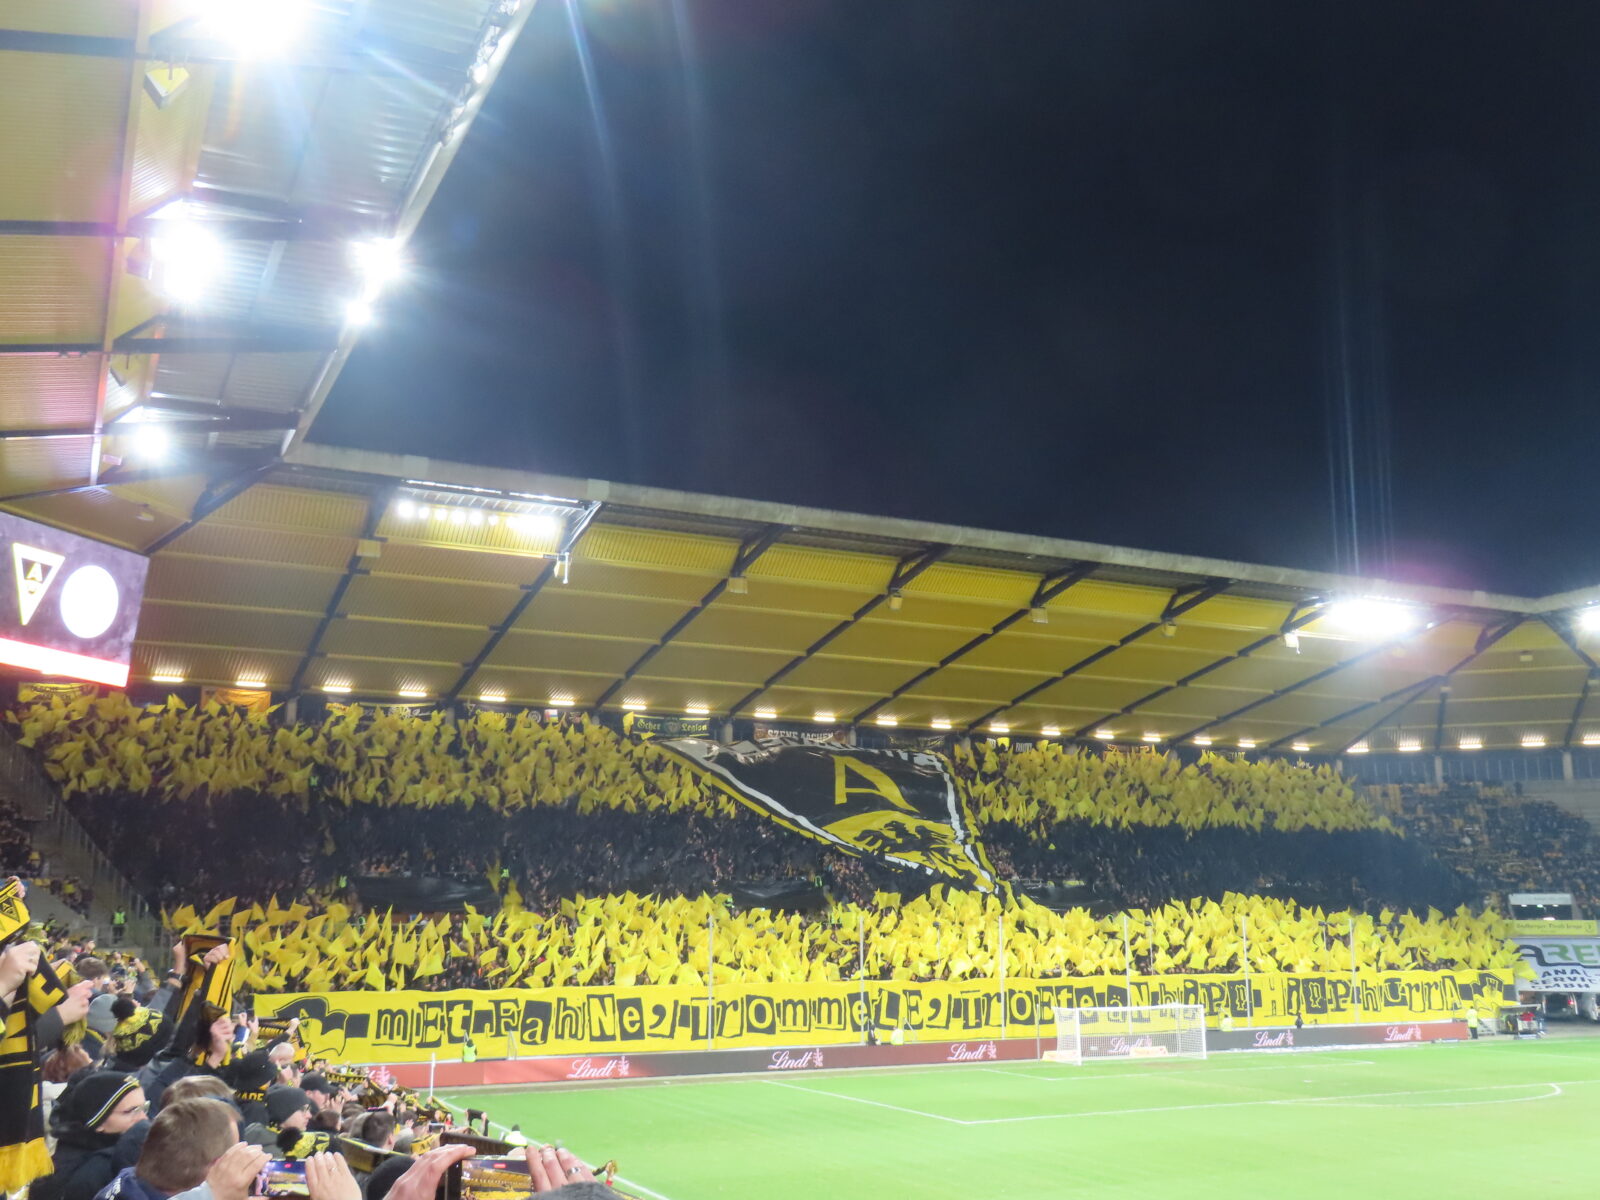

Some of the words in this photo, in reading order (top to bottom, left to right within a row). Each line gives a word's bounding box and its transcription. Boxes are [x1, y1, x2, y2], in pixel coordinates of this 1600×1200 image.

[1513, 944, 1600, 966] ARE
[1253, 1031, 1285, 1047] Lindt
[1384, 1026, 1414, 1041] Lindt
[767, 1050, 812, 1070] Lindt
[947, 1043, 987, 1061] Lindt
[566, 1059, 617, 1079] Lindt
